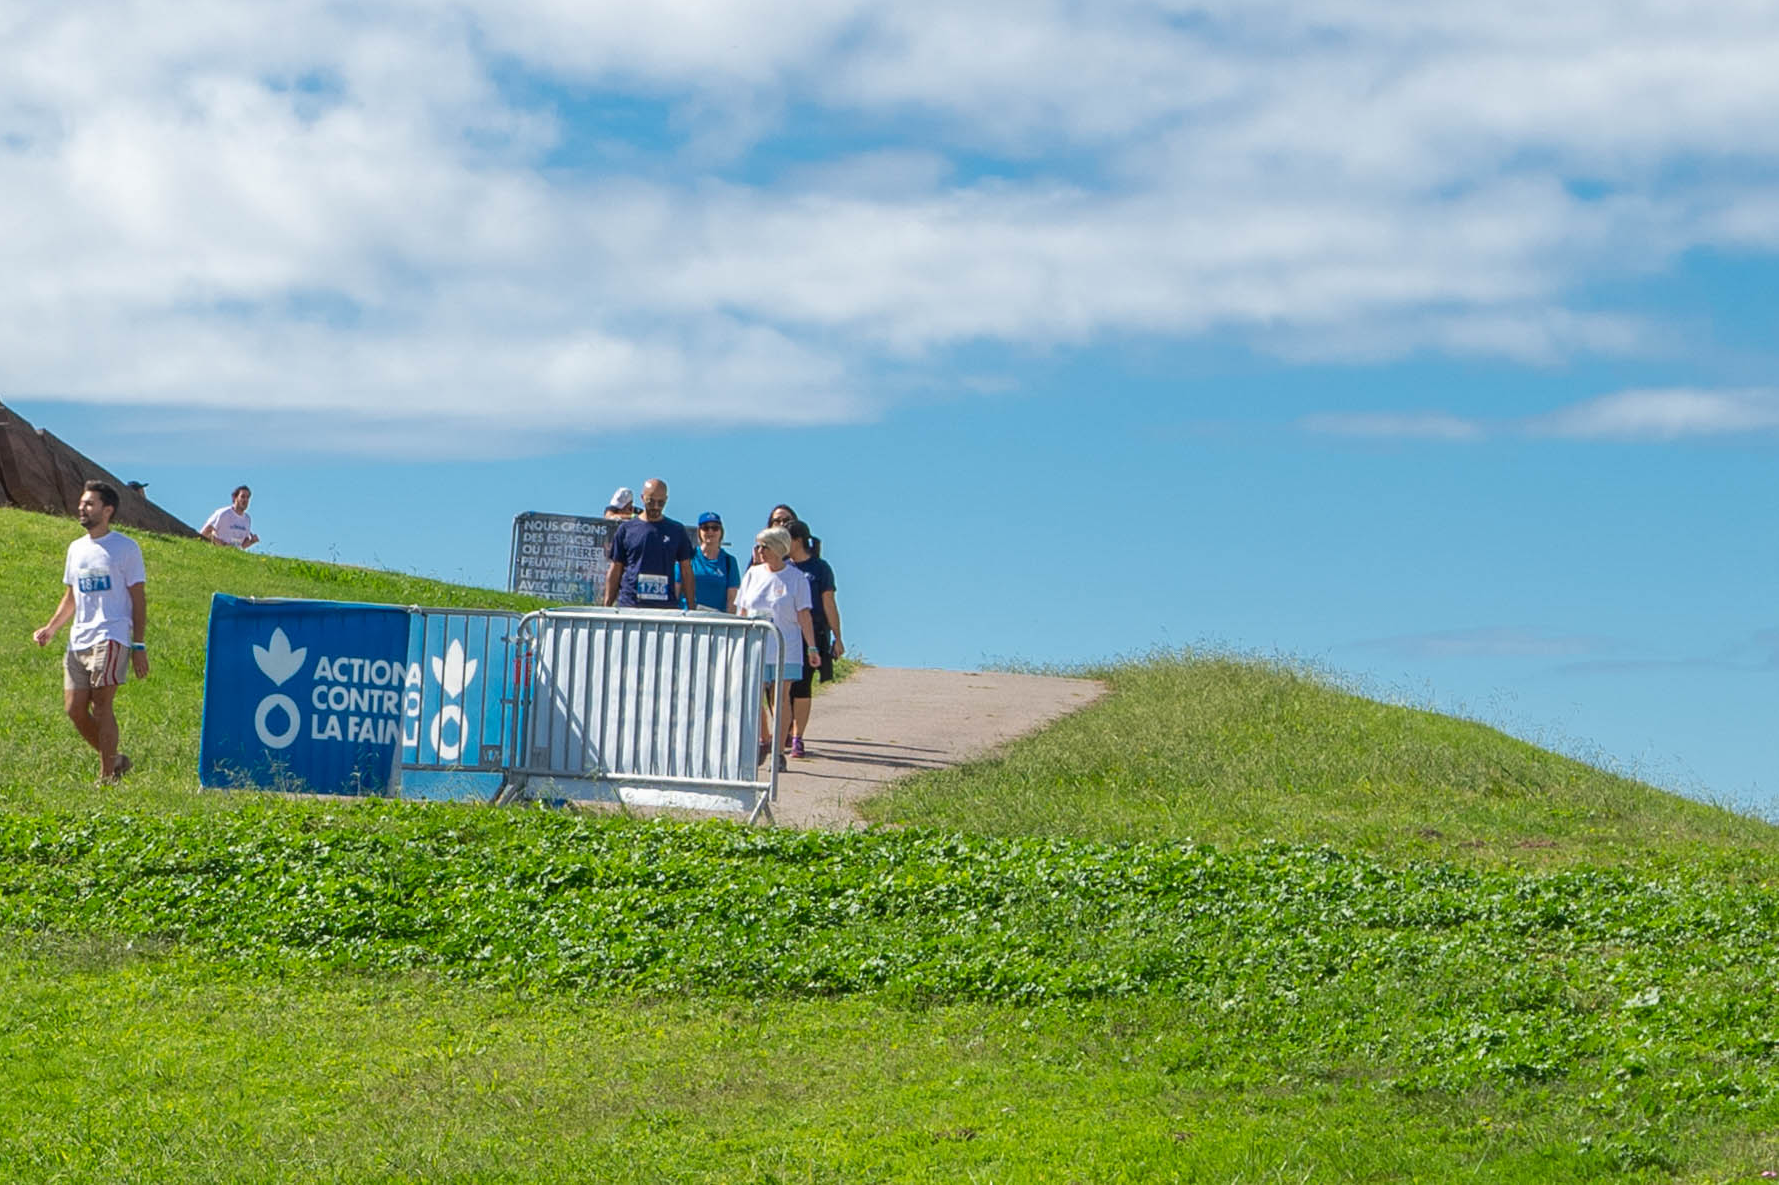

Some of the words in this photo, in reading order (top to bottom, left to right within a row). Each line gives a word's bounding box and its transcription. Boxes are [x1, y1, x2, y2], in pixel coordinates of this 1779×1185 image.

[524, 520, 559, 532] NOUS
[523, 532, 545, 543] DES
[547, 533, 595, 546] ESPACES
[544, 546, 563, 557] LES
[521, 556, 572, 570] PEUVENT
[520, 569, 533, 580] LE
[534, 570, 571, 582] TEMPS
[80, 577, 108, 591] 1871
[518, 580, 550, 593] AVEC
[311, 685, 405, 716] CONTR
[311, 714, 343, 742] LA
